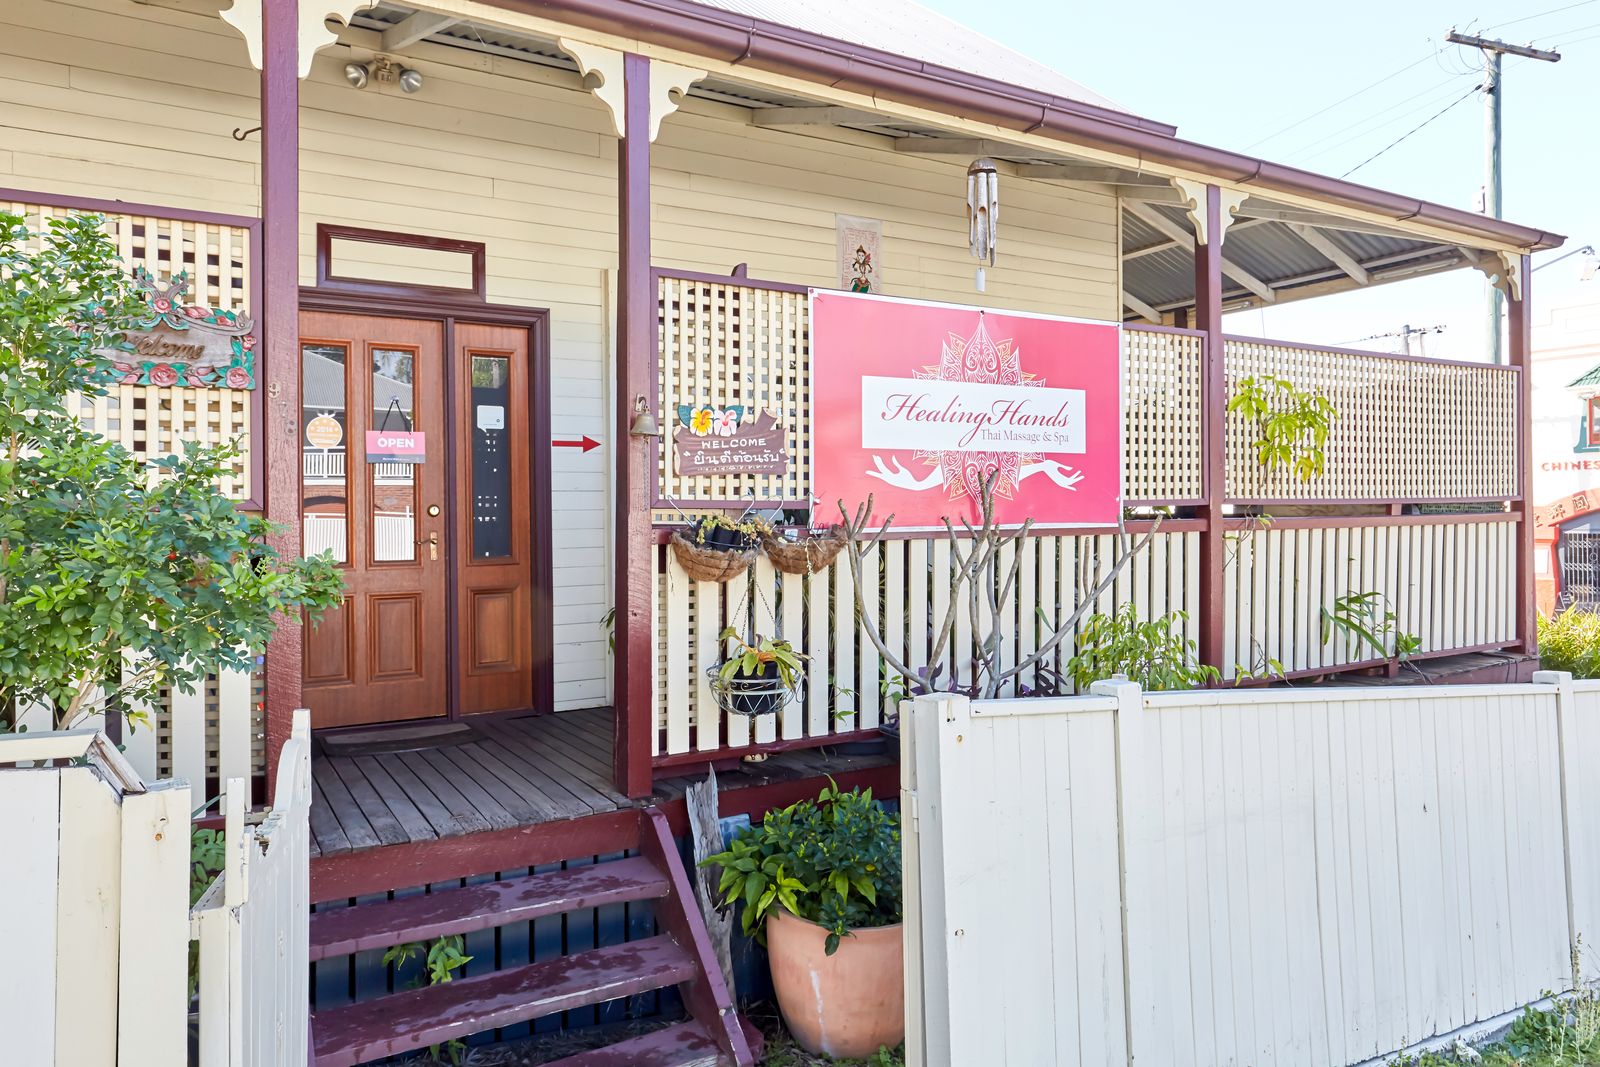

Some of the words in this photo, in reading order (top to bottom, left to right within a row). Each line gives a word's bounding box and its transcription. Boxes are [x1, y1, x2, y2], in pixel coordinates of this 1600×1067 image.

[881, 393, 988, 448] Healing
[987, 399, 1070, 428] Hands
[377, 437, 414, 448] OPEN
[701, 438, 767, 449] WELCOME
[981, 429, 1001, 441] Thai
[1004, 430, 1041, 444] Massage
[1043, 431, 1052, 442] &
[1054, 431, 1069, 445] Spa
